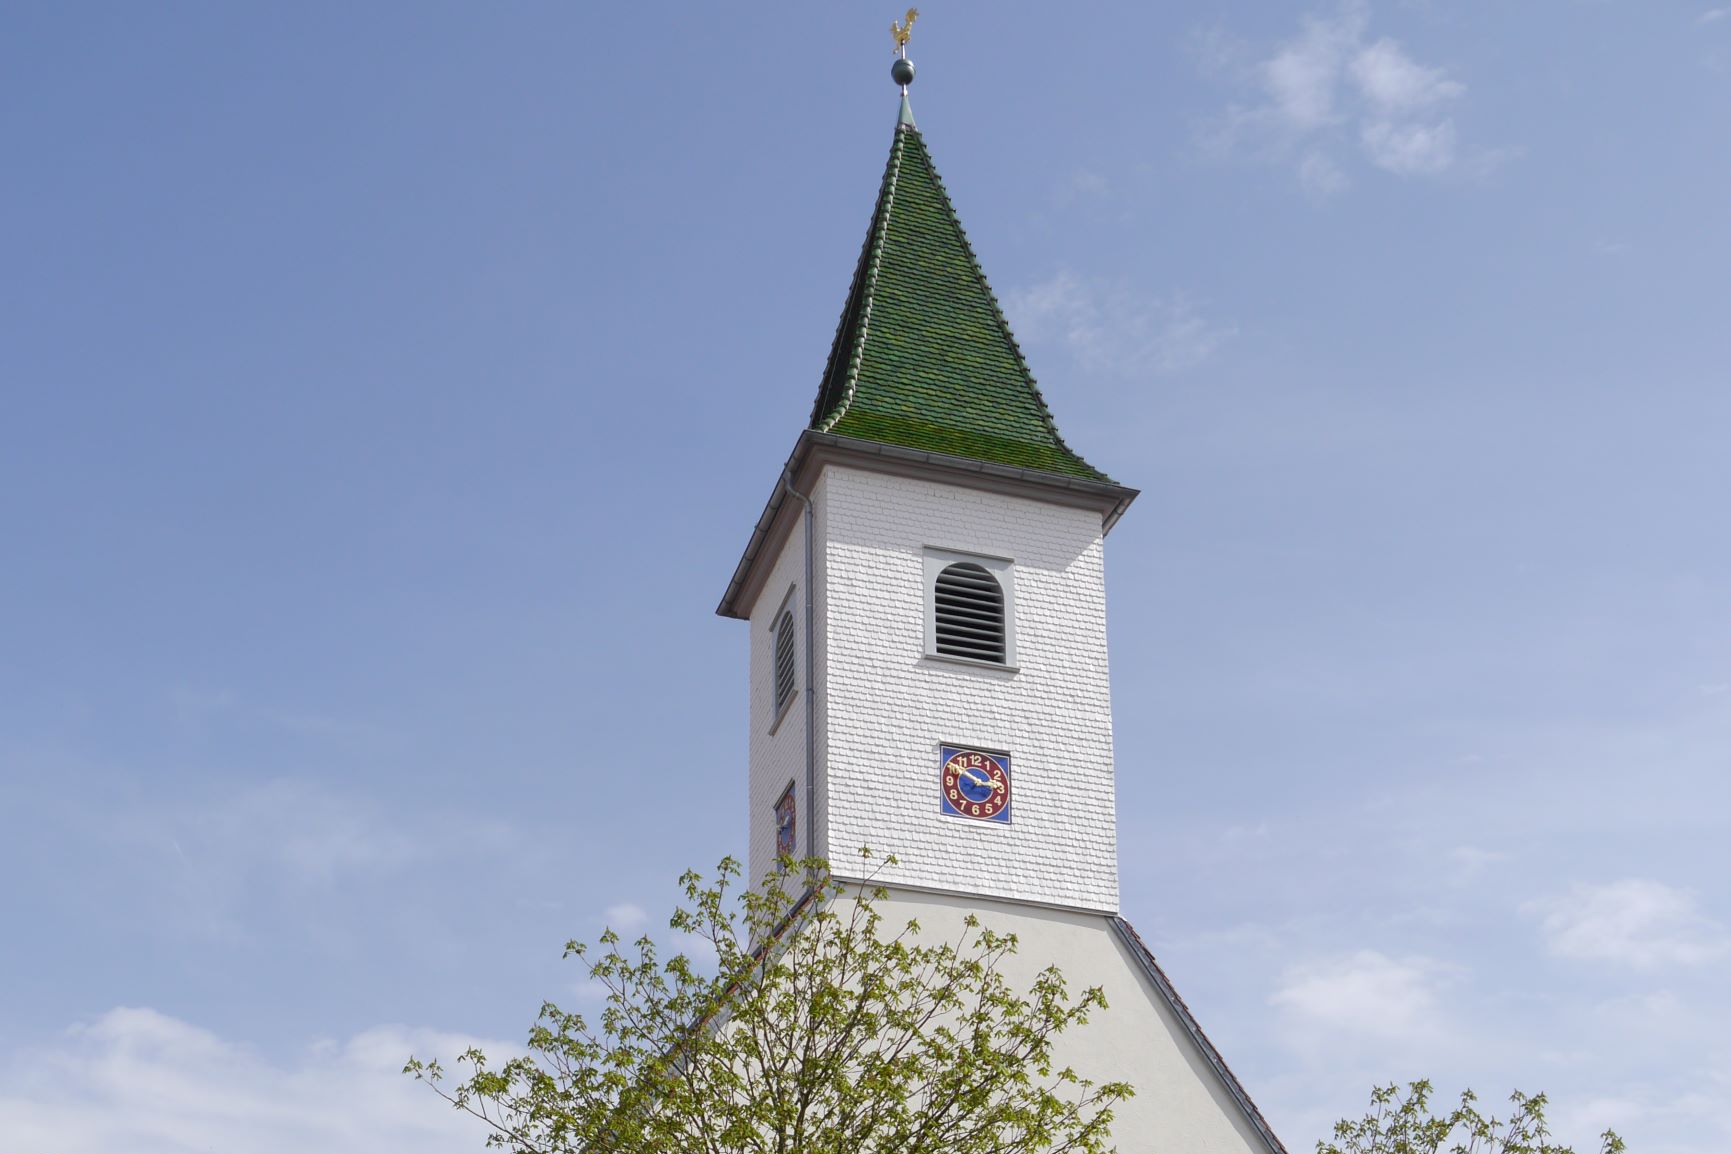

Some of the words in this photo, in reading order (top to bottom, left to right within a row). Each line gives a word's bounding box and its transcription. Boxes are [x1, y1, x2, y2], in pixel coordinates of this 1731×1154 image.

[957, 756, 967, 767] 11
[970, 754, 982, 766] 12
[984, 760, 990, 770] 1
[994, 770, 1002, 780] 2
[946, 776, 954, 786] 9
[996, 783, 1004, 794] 3
[950, 790, 958, 800] 8
[960, 800, 967, 810] 7
[994, 796, 1002, 806] 4
[972, 804, 980, 815] 6
[985, 804, 993, 814] 5
